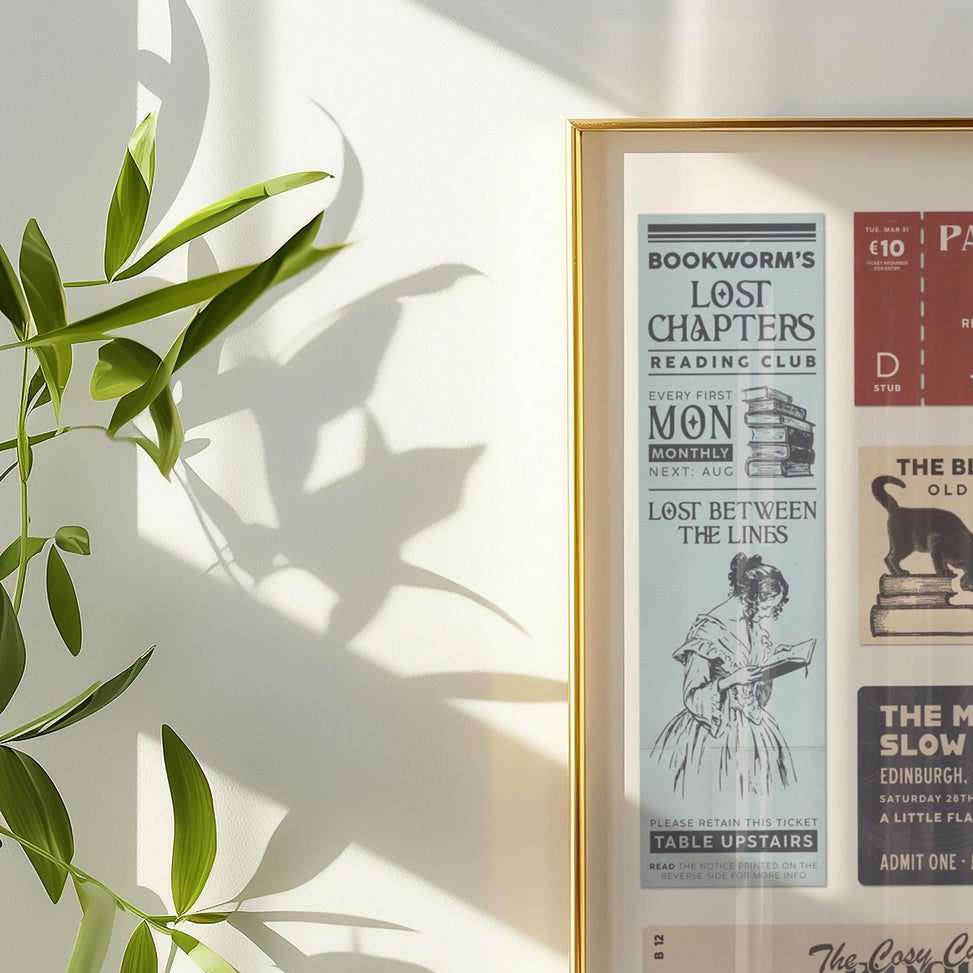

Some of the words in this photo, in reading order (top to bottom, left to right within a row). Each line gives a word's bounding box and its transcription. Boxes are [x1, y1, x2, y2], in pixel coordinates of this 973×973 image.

[869, 240, 904, 257] €10
[648, 251, 815, 269] BOOKWORM'S
[690, 279, 772, 309] LOST
[648, 313, 815, 342] CHAPTERS
[650, 356, 750, 369] READING
[761, 355, 816, 368] CLUB
[649, 391, 691, 401] EVERY
[696, 390, 733, 400] FIRST
[873, 384, 901, 392] STUB
[648, 404, 733, 440] MON
[651, 447, 729, 459] MONTHLY
[649, 467, 695, 477] NEXT:
[702, 466, 733, 476] AUG
[897, 458, 944, 476] THE
[928, 484, 967, 496] OLD
[648, 502, 702, 521] LOST
[709, 501, 817, 520] BETWEEN
[678, 526, 720, 544] THE
[728, 525, 788, 544] LINES
[880, 705, 942, 727] THE
[880, 734, 966, 756] SLOW
[880, 795, 941, 803] SATURDAY
[651, 819, 694, 827] PLEASE
[699, 819, 740, 827] RETAIN
[746, 818, 772, 827] THIS
[777, 818, 818, 826] TICKET
[880, 812, 889, 823] A
[894, 812, 942, 823] LITTLE
[654, 836, 714, 848] TABLE
[721, 835, 813, 848] UPSTAIRS
[880, 853, 925, 871] ADMIT
[929, 853, 957, 870] ONE
[654, 934, 664, 947] 12
[654, 952, 664, 960] B
[808, 942, 858, 973] The
[869, 938, 932, 973] Cosy
